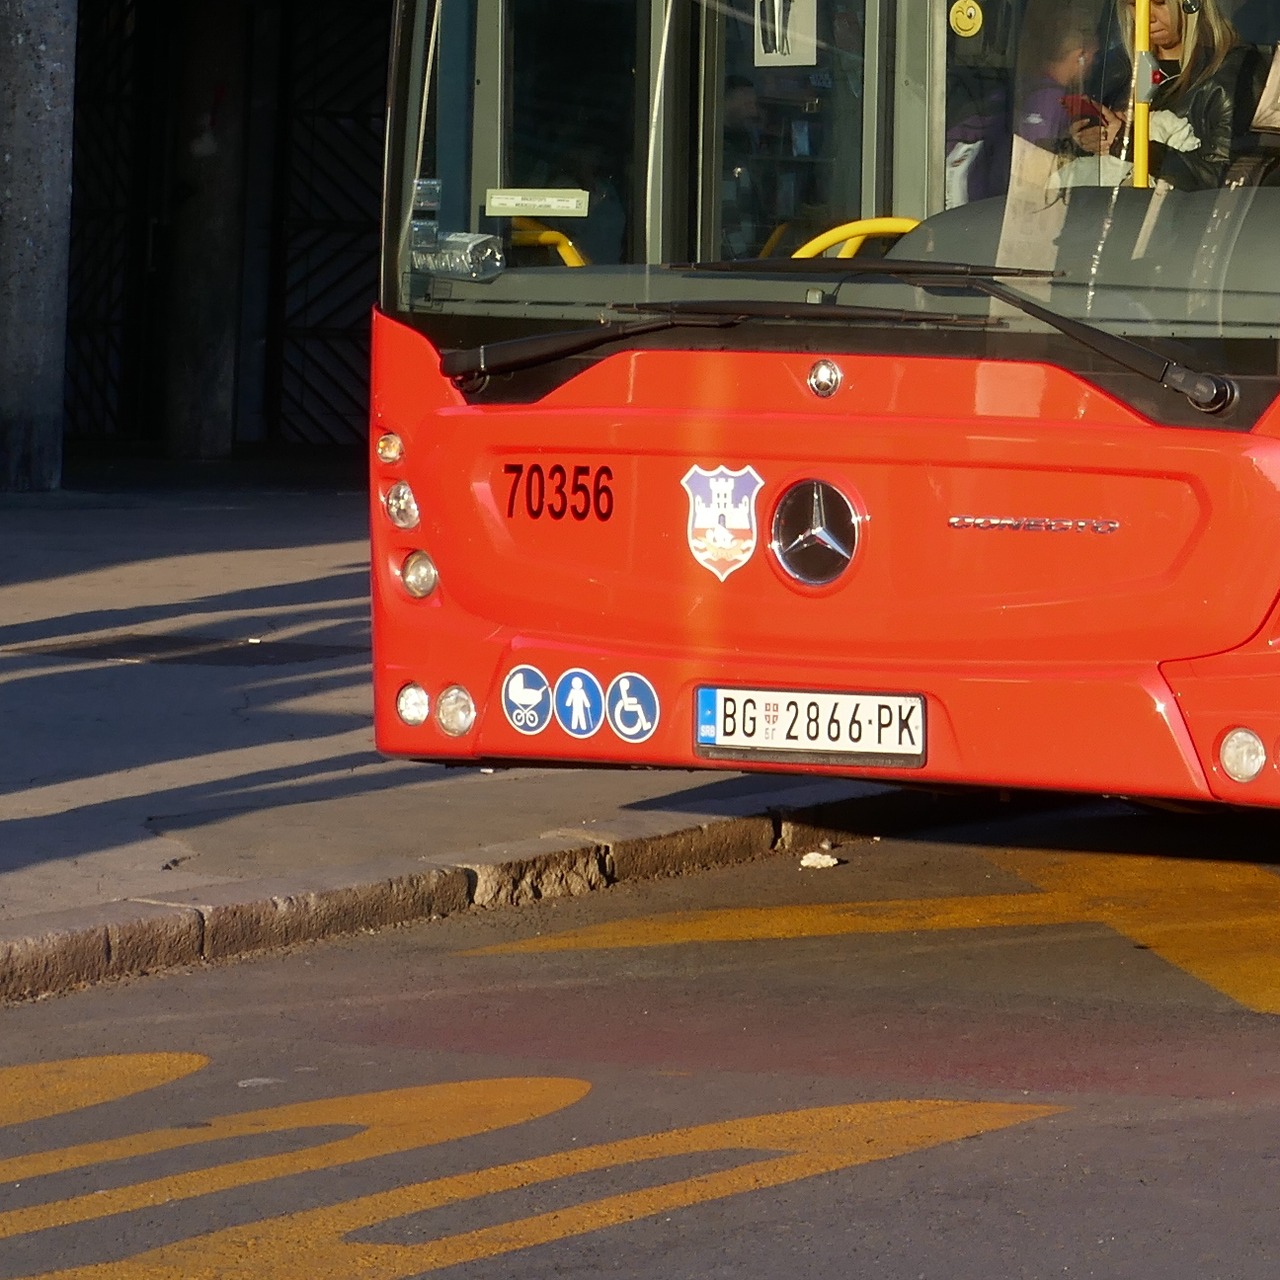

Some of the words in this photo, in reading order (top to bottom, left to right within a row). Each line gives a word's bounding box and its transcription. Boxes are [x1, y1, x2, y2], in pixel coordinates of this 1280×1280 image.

[504, 463, 614, 522] 70356
[700, 724, 716, 738] SRB
[722, 696, 758, 738] BG
